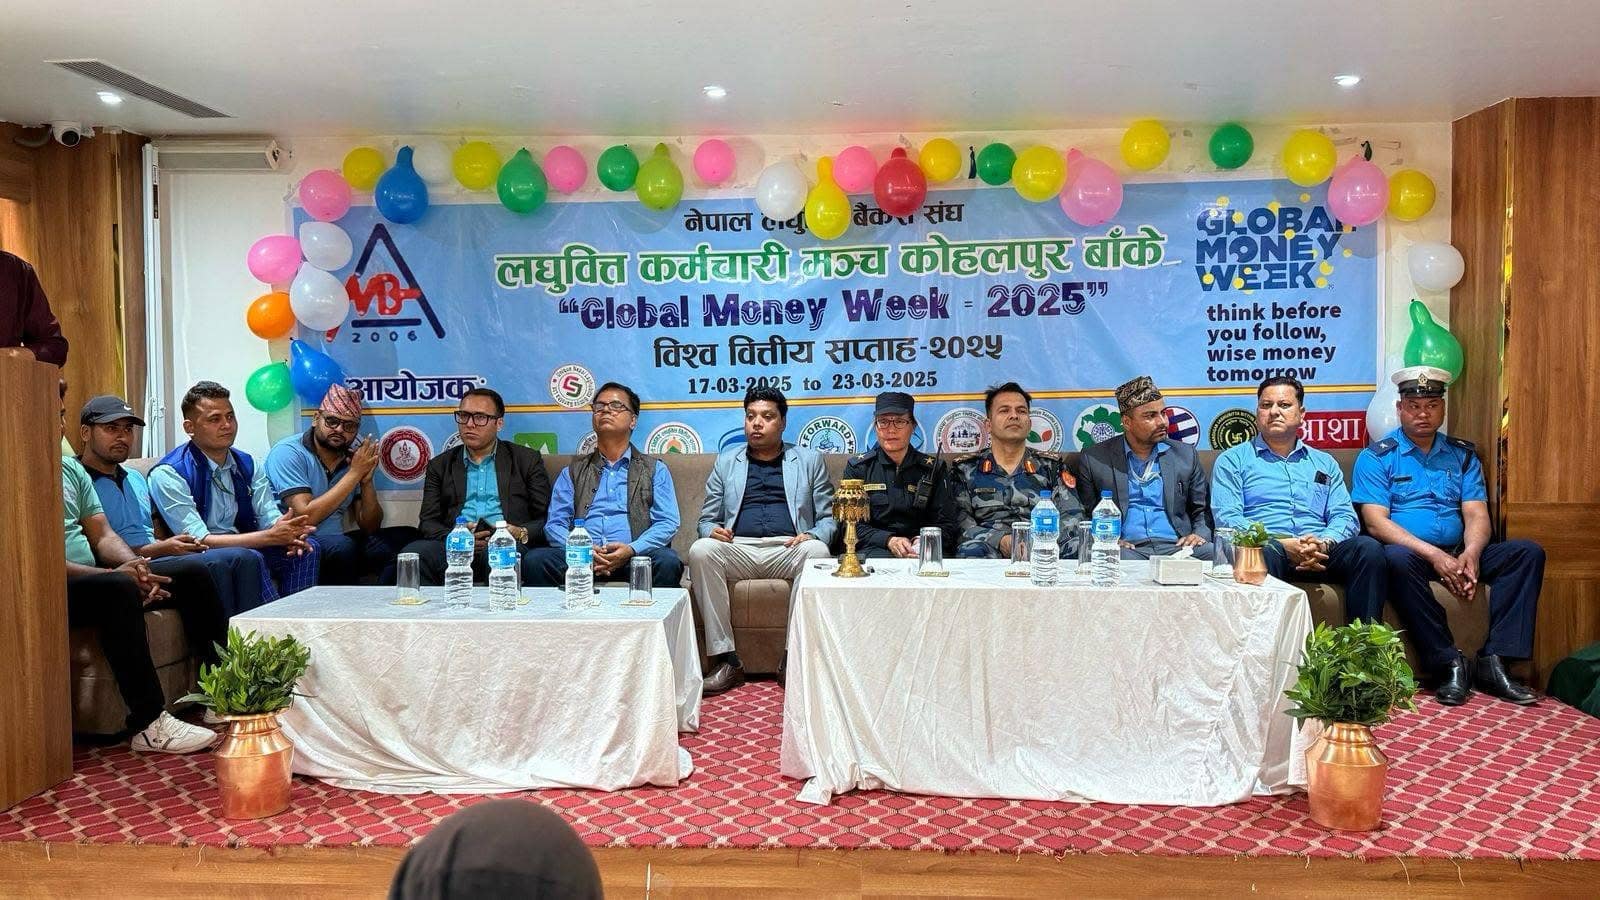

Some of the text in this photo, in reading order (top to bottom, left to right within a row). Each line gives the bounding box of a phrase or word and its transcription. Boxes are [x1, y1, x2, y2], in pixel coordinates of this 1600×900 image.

[684, 208, 753, 233] नेपाल
[923, 200, 965, 225] संघ
[495, 225, 1166, 294] लघुवित्त कर्मचारी मञ्च कोहलपुर बाँके
[1196, 234, 1342, 264] MONEY
[1195, 262, 1317, 292] WEEK
[702, 293, 828, 332] Money
[842, 286, 950, 322] Week
[1207, 301, 1342, 321] think before
[352, 330, 418, 343] 2006
[1207, 322, 1327, 346] you follow,
[653, 336, 719, 368] विश्व
[728, 334, 815, 367] वित्तीय
[1207, 344, 1336, 363] wise money
[688, 371, 938, 394] 17-03-2025 to 23-03-2025
[1207, 366, 1316, 382] tomorrow
[803, 419, 851, 441] FORWARD
[1296, 418, 1363, 442] आशा
